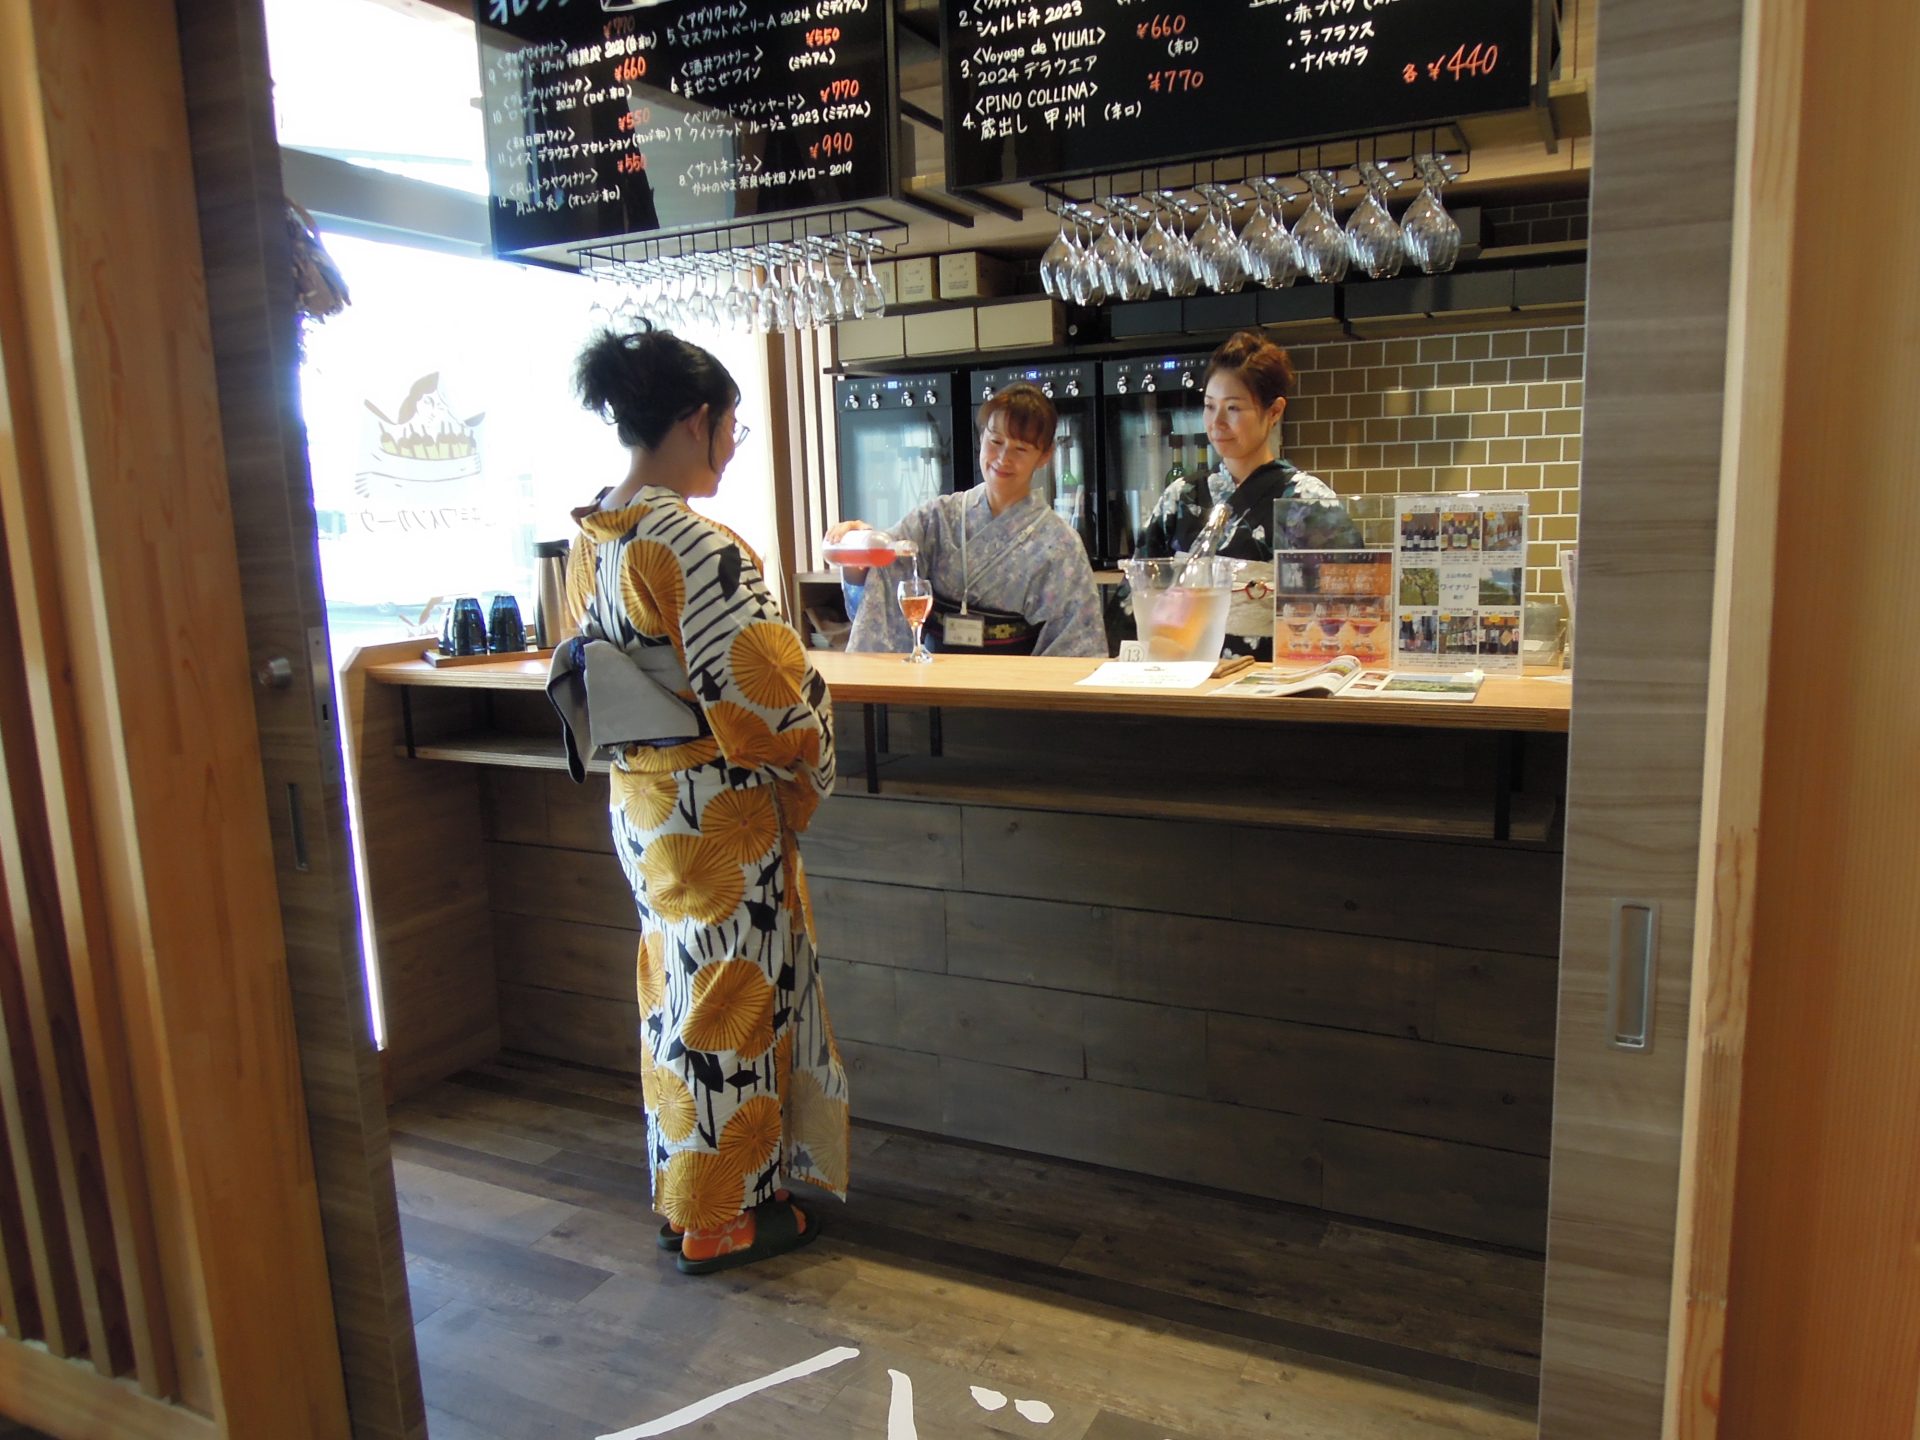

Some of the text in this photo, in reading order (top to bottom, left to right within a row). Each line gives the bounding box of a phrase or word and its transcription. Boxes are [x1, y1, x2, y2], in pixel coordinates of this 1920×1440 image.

[780, 6, 812, 25] 2024
[976, 7, 1041, 37] シャルドネ
[1044, 0, 1084, 24] 2023
[1136, 14, 1186, 40] ¥660
[805, 27, 841, 48] ¥550
[1031, 38, 1048, 54] de
[614, 56, 647, 82] ¥660
[977, 67, 1020, 87] 2024
[1024, 54, 1098, 80] デラウエア
[1300, 45, 1369, 74] ナイヤガラ
[1427, 42, 1499, 82] ¥440
[820, 79, 860, 103] ¥770
[1147, 69, 1204, 93] ¥770
[791, 108, 819, 127] 2023
[980, 113, 1028, 142] 蔵出し
[1044, 104, 1086, 131] 甲州
[809, 132, 853, 159] ¥990
